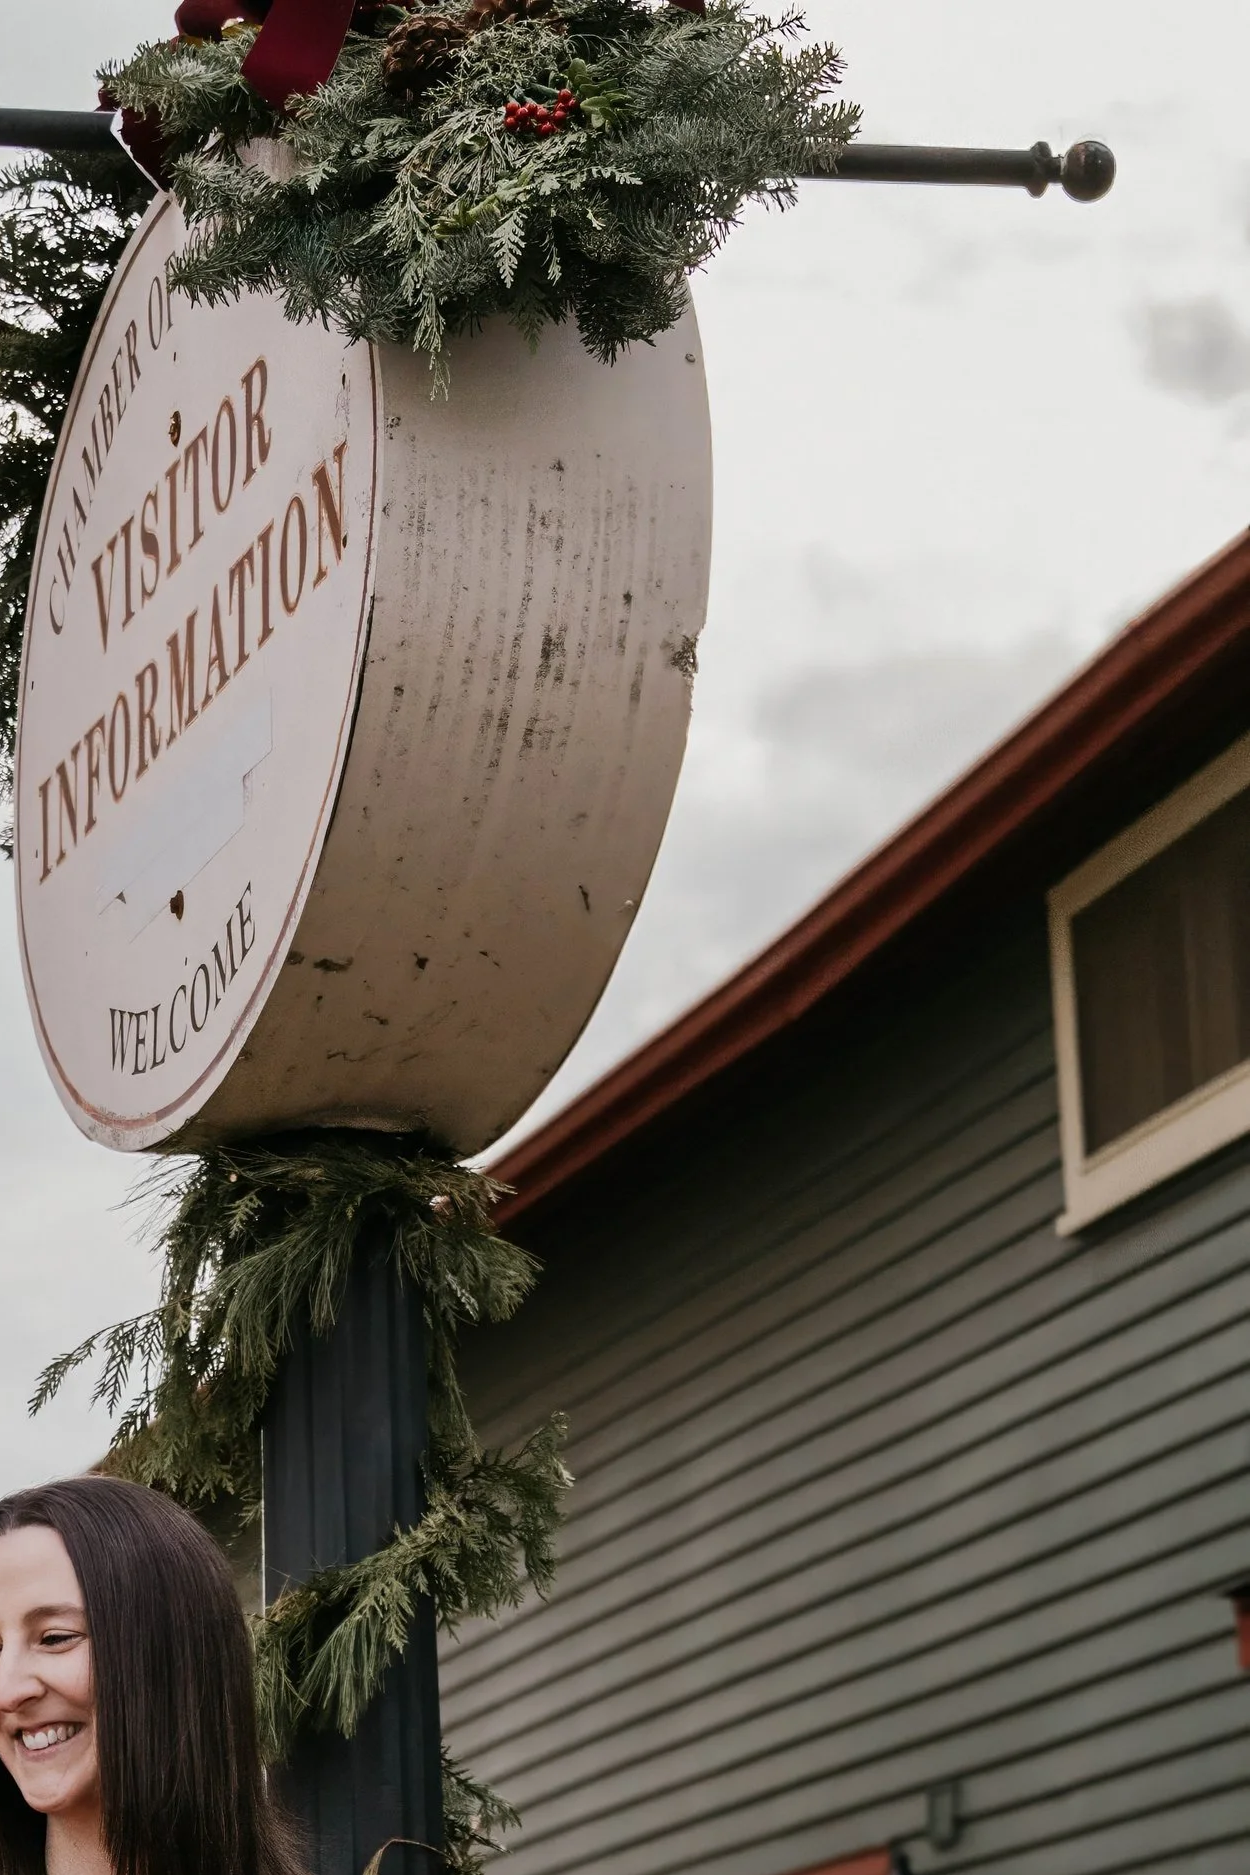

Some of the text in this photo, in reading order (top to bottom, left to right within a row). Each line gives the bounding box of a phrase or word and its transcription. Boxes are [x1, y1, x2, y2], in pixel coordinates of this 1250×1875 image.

[49, 320, 141, 636] CHAMBER
[90, 355, 272, 654] VISITOR
[37, 441, 348, 886] INFORMATION
[108, 881, 257, 1077] WELCOME
